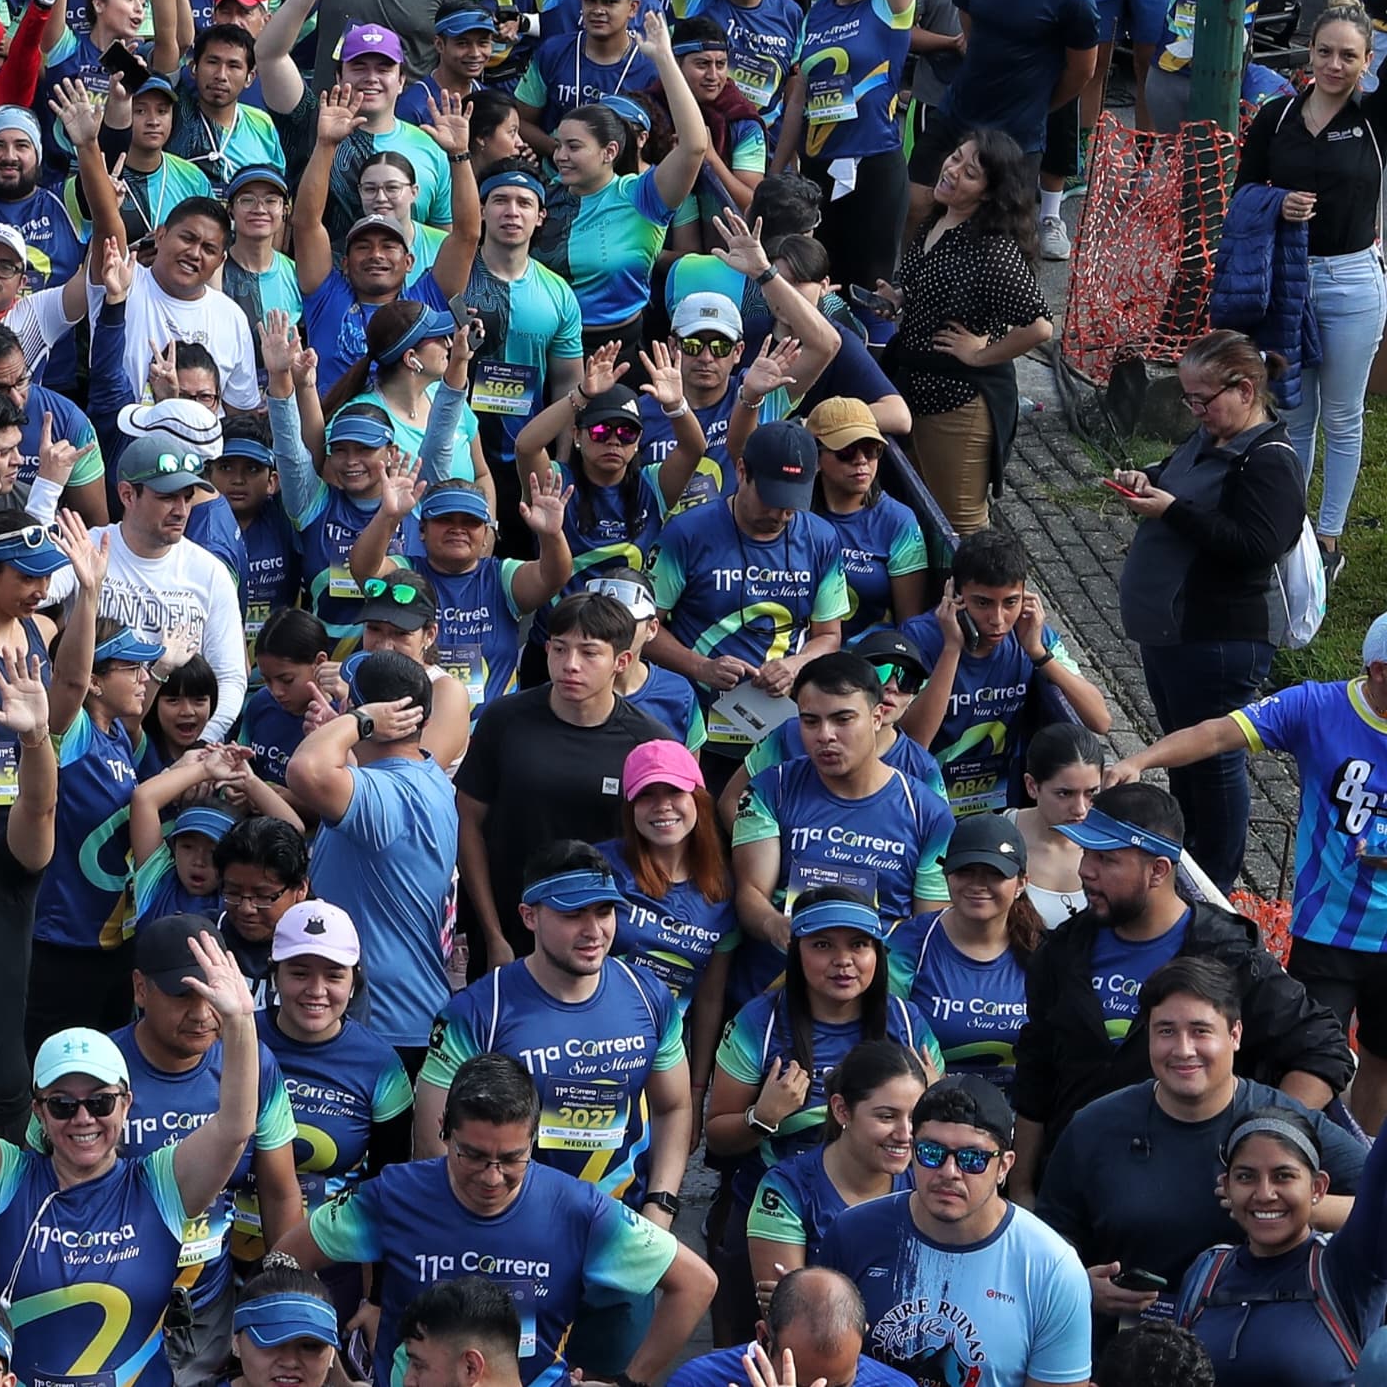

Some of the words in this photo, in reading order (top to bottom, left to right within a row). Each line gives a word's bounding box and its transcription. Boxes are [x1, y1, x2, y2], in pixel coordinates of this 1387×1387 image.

[484, 382, 525, 398] 3869
[1336, 760, 1378, 835] 86
[827, 825, 906, 856] Carrera
[564, 1033, 646, 1058] Carrera
[557, 1108, 617, 1128] 2027
[562, 1138, 603, 1149] MEDALLA
[461, 1251, 550, 1278] Carrera
[872, 1298, 929, 1343] ENTRE
[938, 1299, 986, 1362] RUINAS
